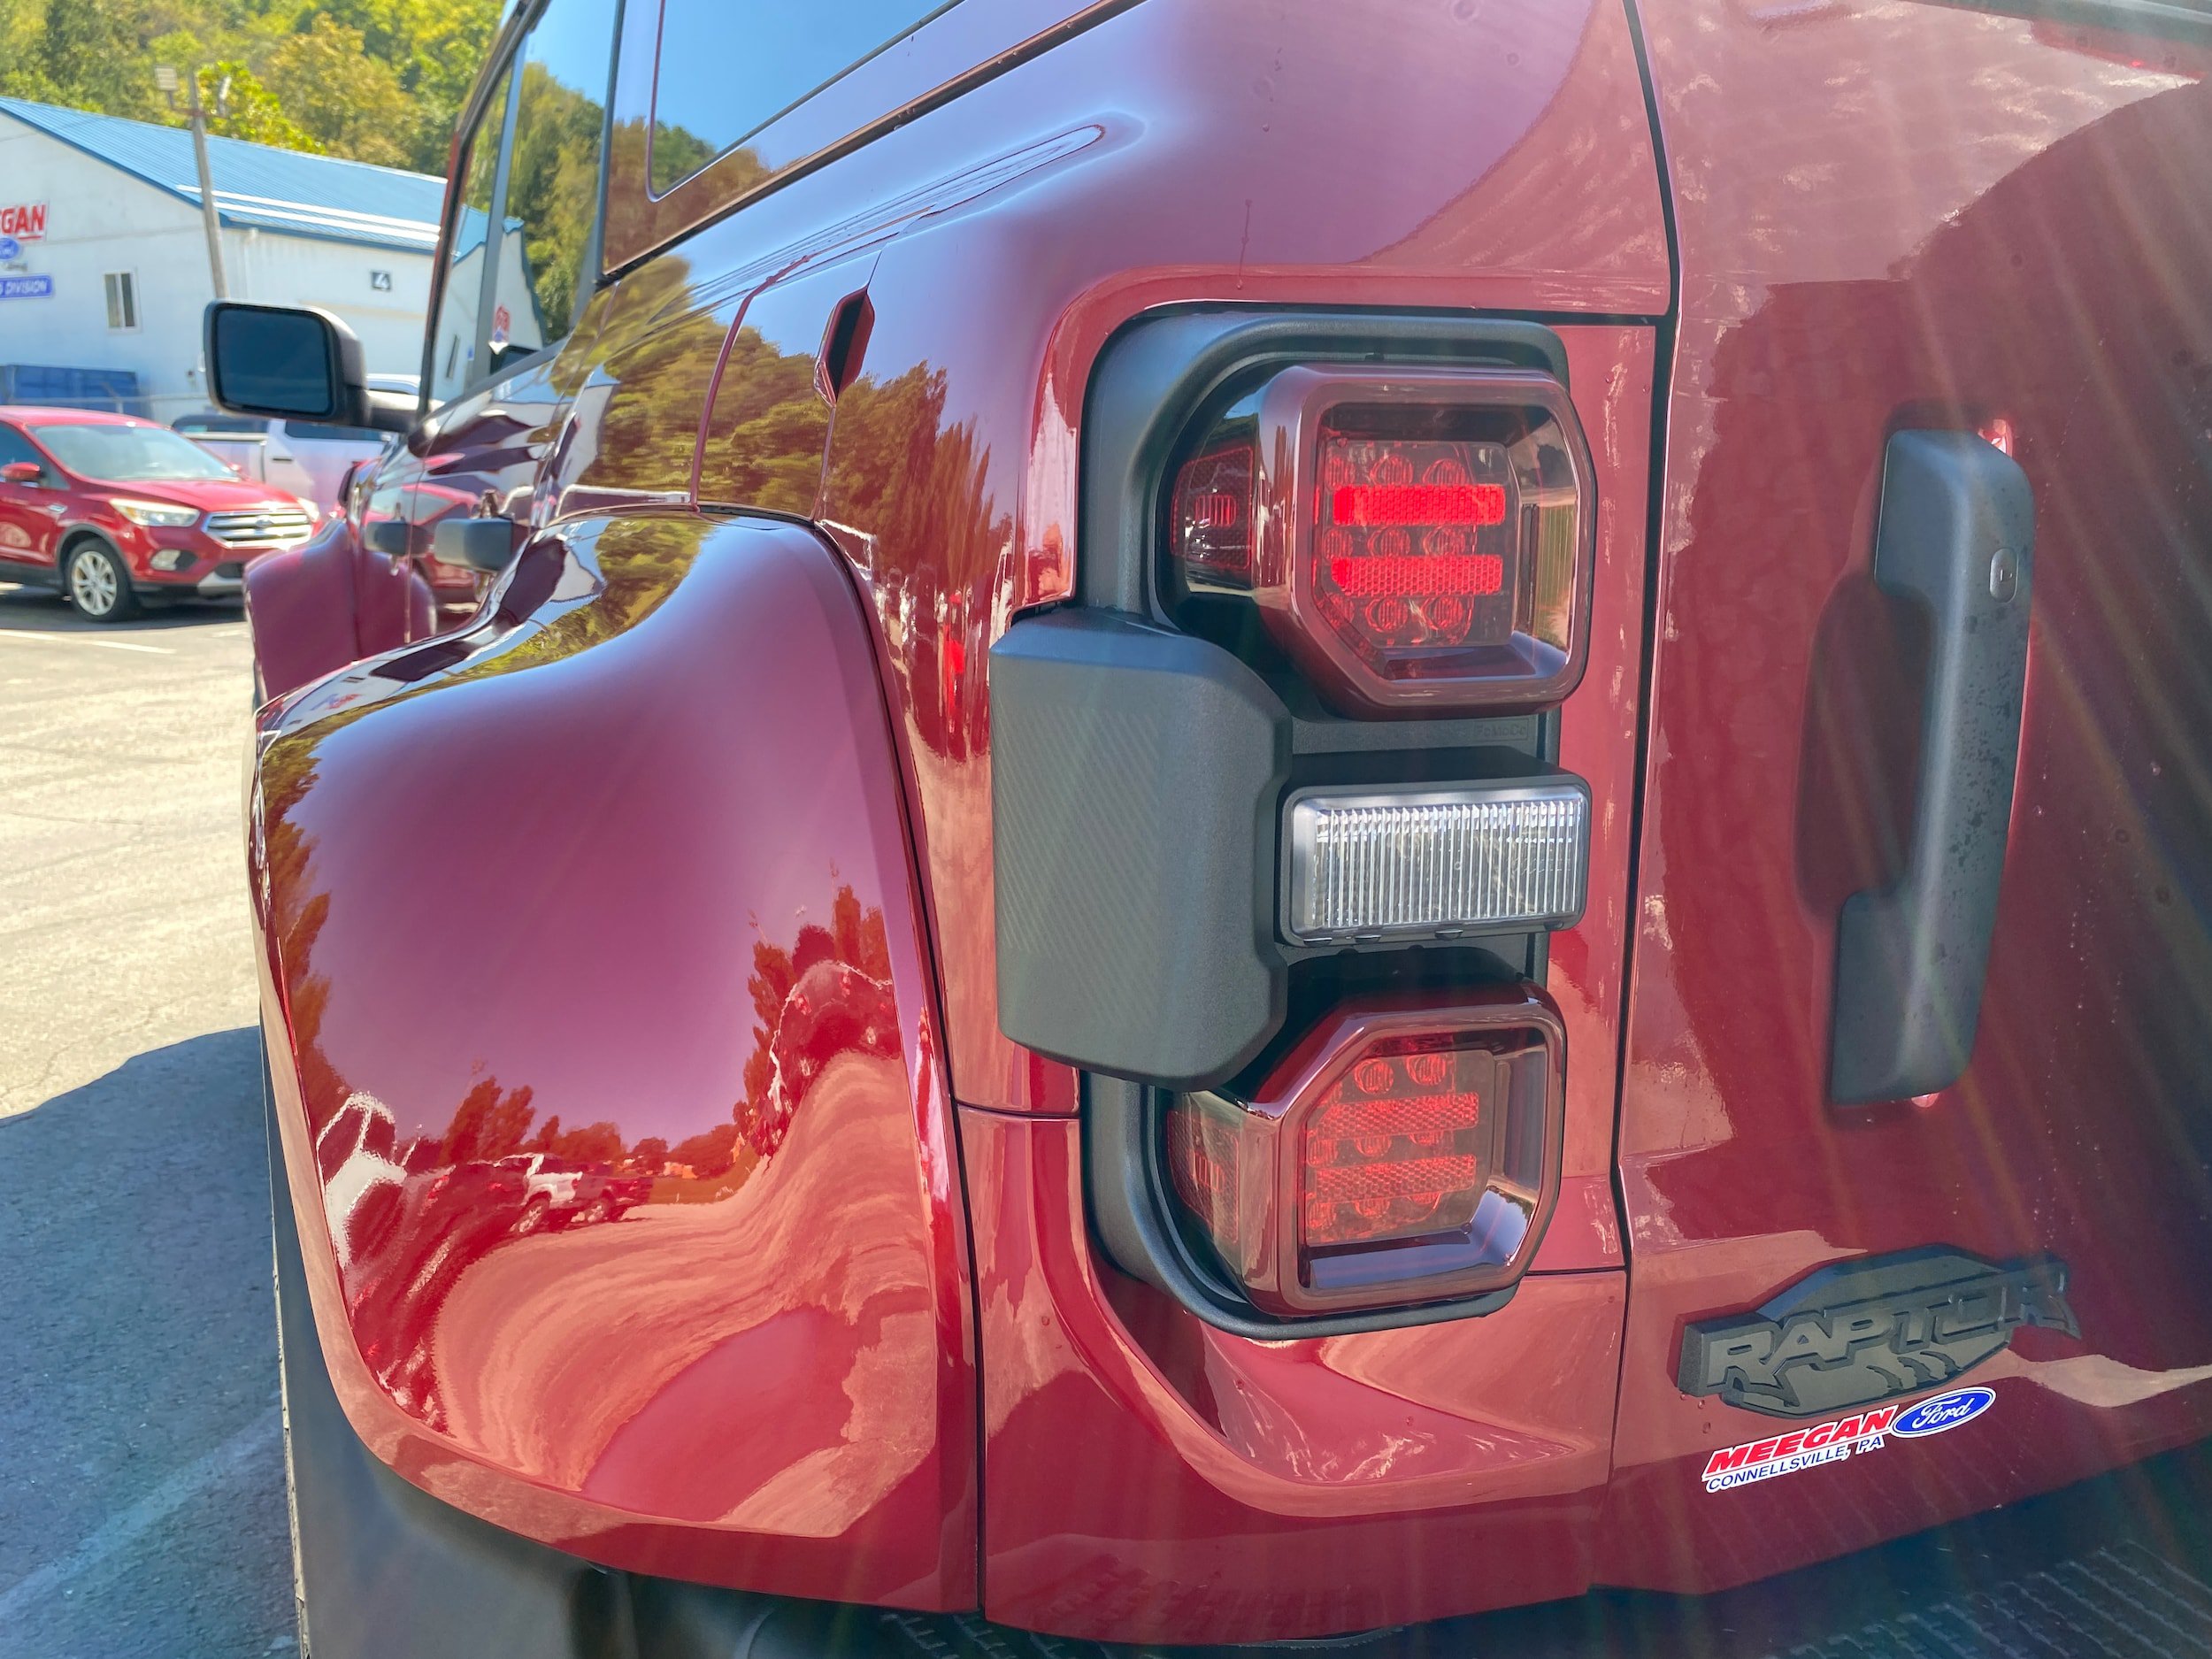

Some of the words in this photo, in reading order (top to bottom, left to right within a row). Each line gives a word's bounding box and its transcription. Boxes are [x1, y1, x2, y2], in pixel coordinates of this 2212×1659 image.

[0, 204, 46, 234] GAN
[1701, 1262, 2080, 1407] RAPTOR
[1706, 1409, 1894, 1474] MEEGAN
[1911, 1396, 1976, 1429] Ford
[1709, 1445, 1849, 1491] CONNELLSVILLE,
[1858, 1435, 1883, 1453] PA
